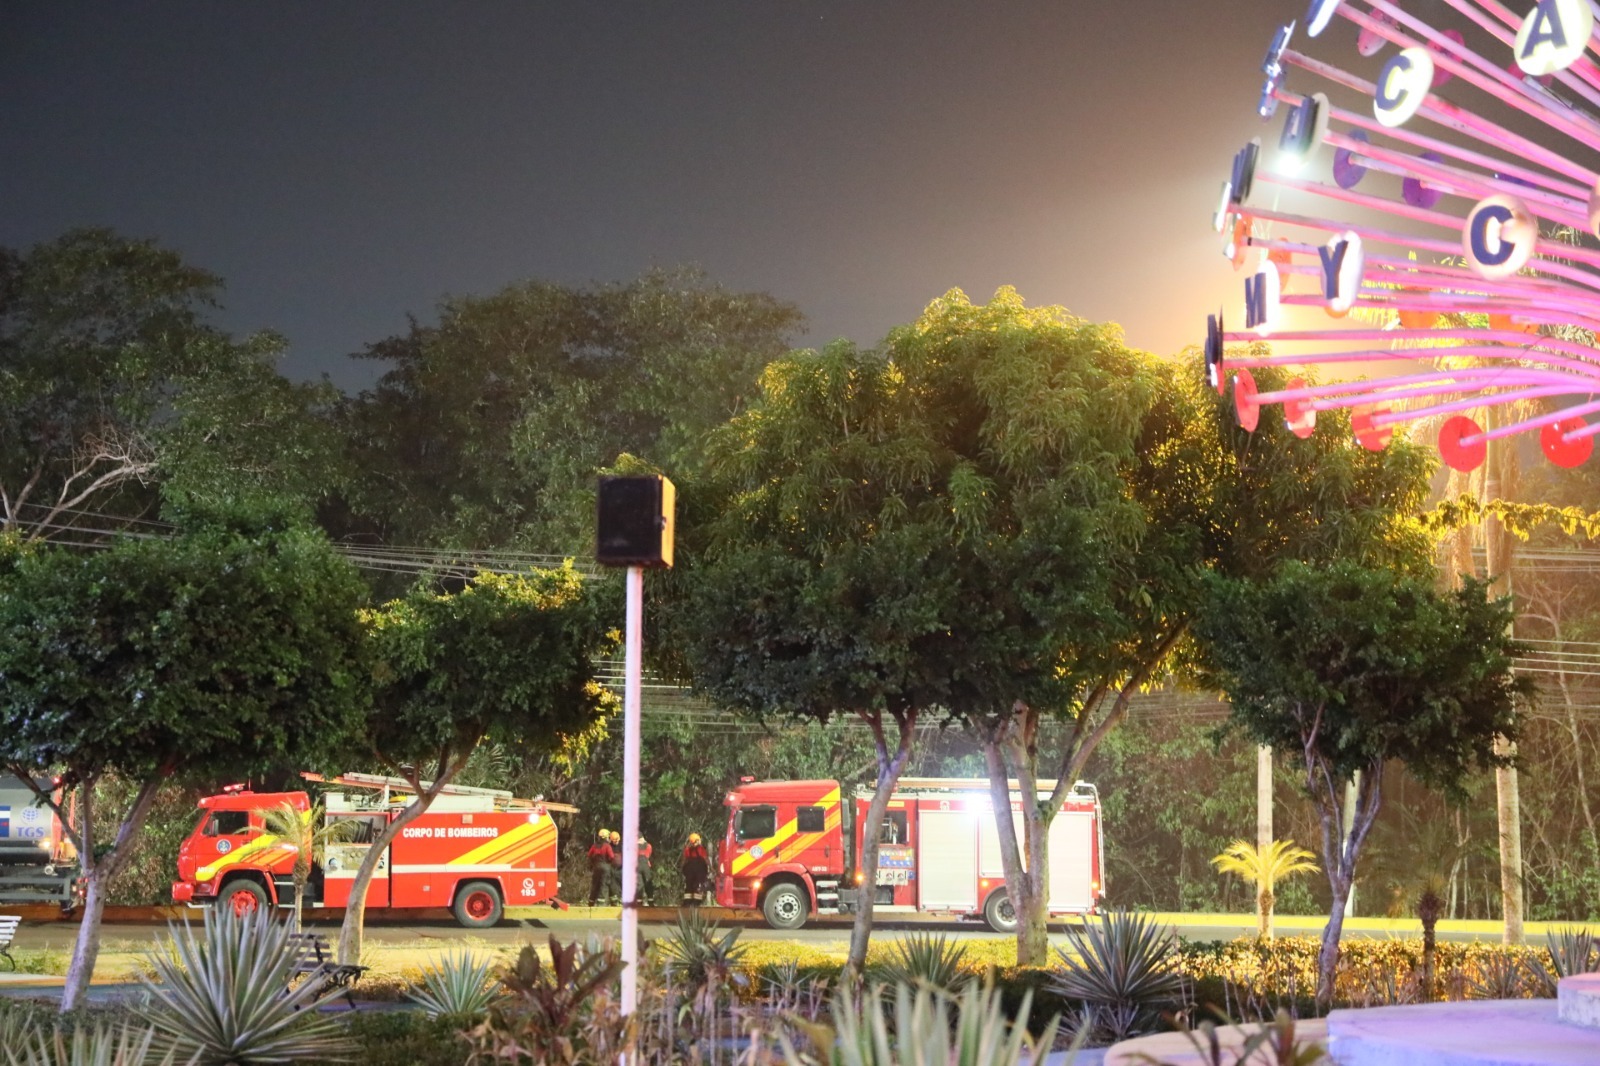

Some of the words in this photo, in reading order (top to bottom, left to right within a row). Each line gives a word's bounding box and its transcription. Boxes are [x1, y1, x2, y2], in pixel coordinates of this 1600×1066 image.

[1520, 0, 1569, 59] A
[1375, 54, 1413, 112] C
[1470, 205, 1515, 266] C
[1317, 240, 1349, 300] Y
[16, 827, 45, 838] TGS
[402, 827, 433, 838] CORPO
[434, 827, 446, 838] DE
[447, 827, 499, 838] BOMBEIROS
